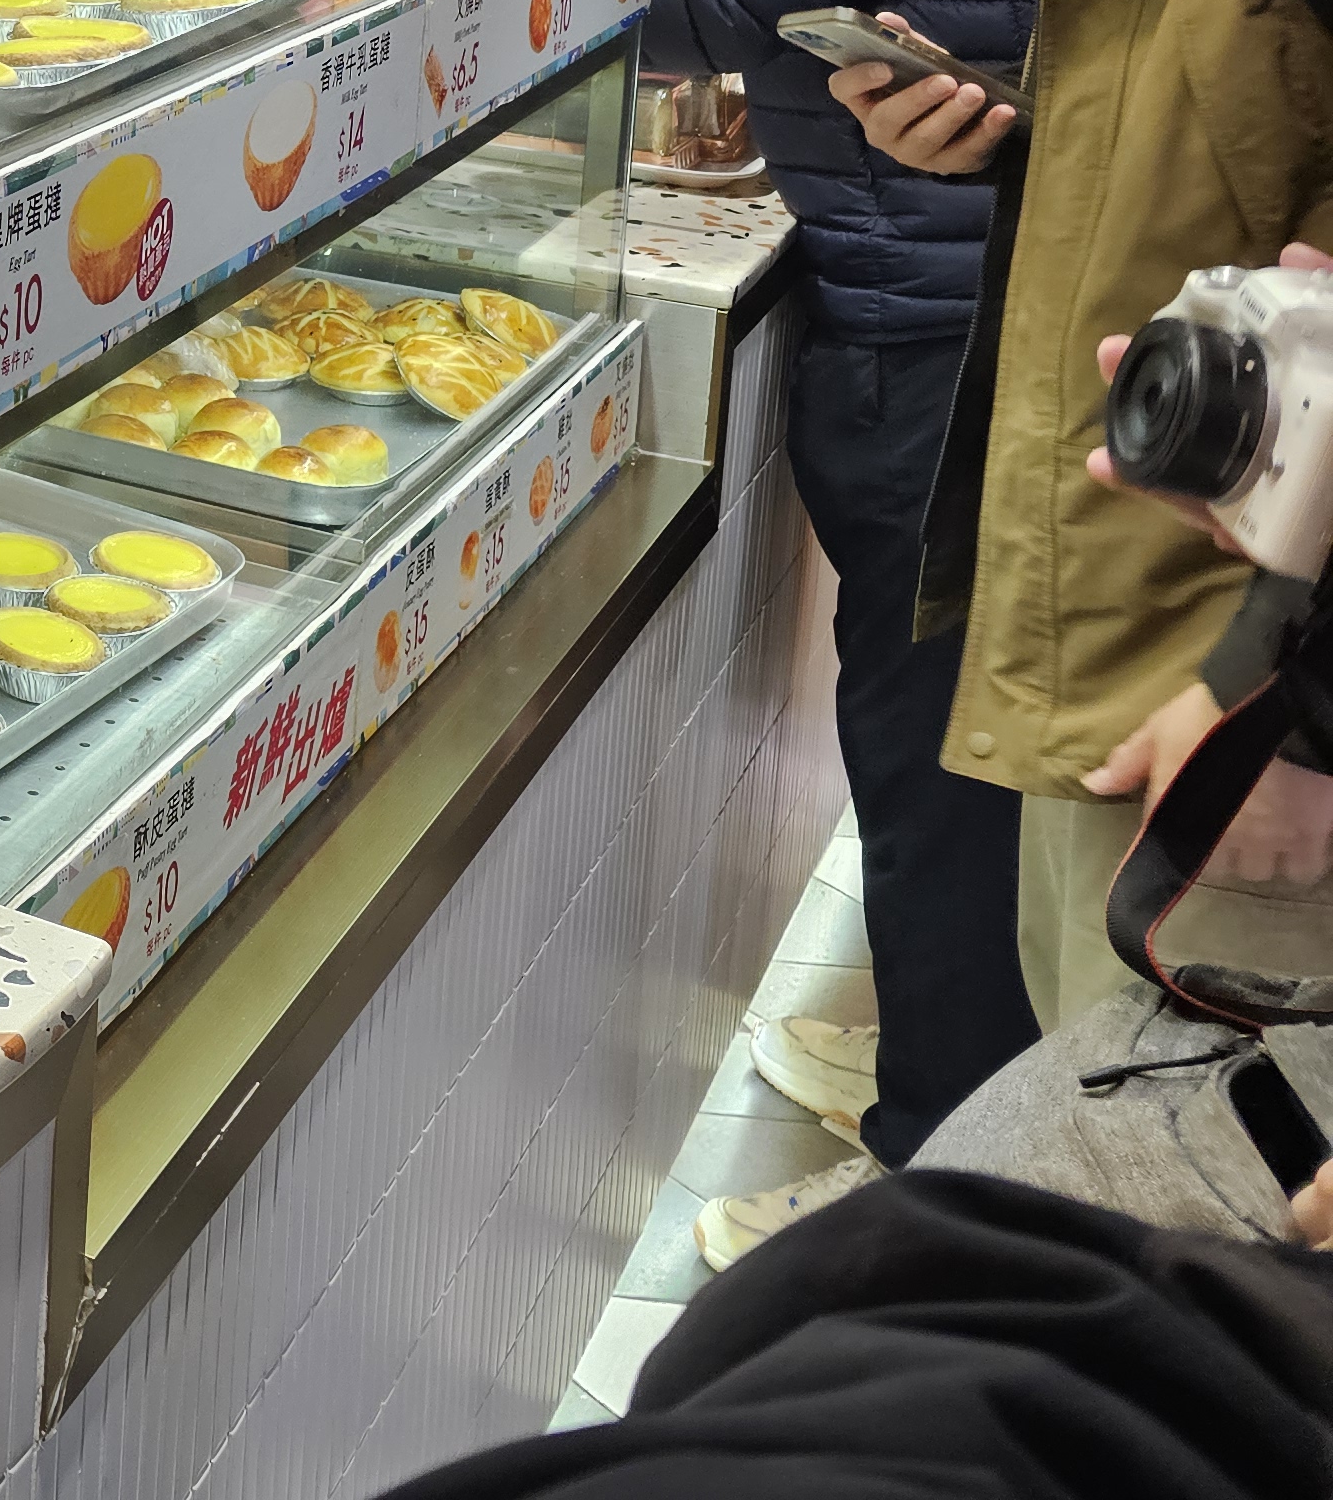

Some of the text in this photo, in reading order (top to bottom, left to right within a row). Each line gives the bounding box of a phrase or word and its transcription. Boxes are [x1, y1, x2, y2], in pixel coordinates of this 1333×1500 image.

[320, 30, 391, 93] 香滑牛乳蛋撻
[451, 41, 480, 95] $6.5
[337, 103, 366, 162] $14
[8, 248, 37, 273] Egg Tart
[141, 201, 171, 265] HOT
[1, 347, 35, 376] 每件 pc
[614, 396, 630, 440] $15
[553, 456, 571, 503] $15
[405, 538, 435, 592] 皮蛋酥
[485, 523, 505, 576] $15
[404, 599, 430, 657] $15
[223, 664, 356, 831] 新鮮出爐
[132, 776, 195, 863] 酥皮蛋撻
[144, 860, 179, 935] $10
